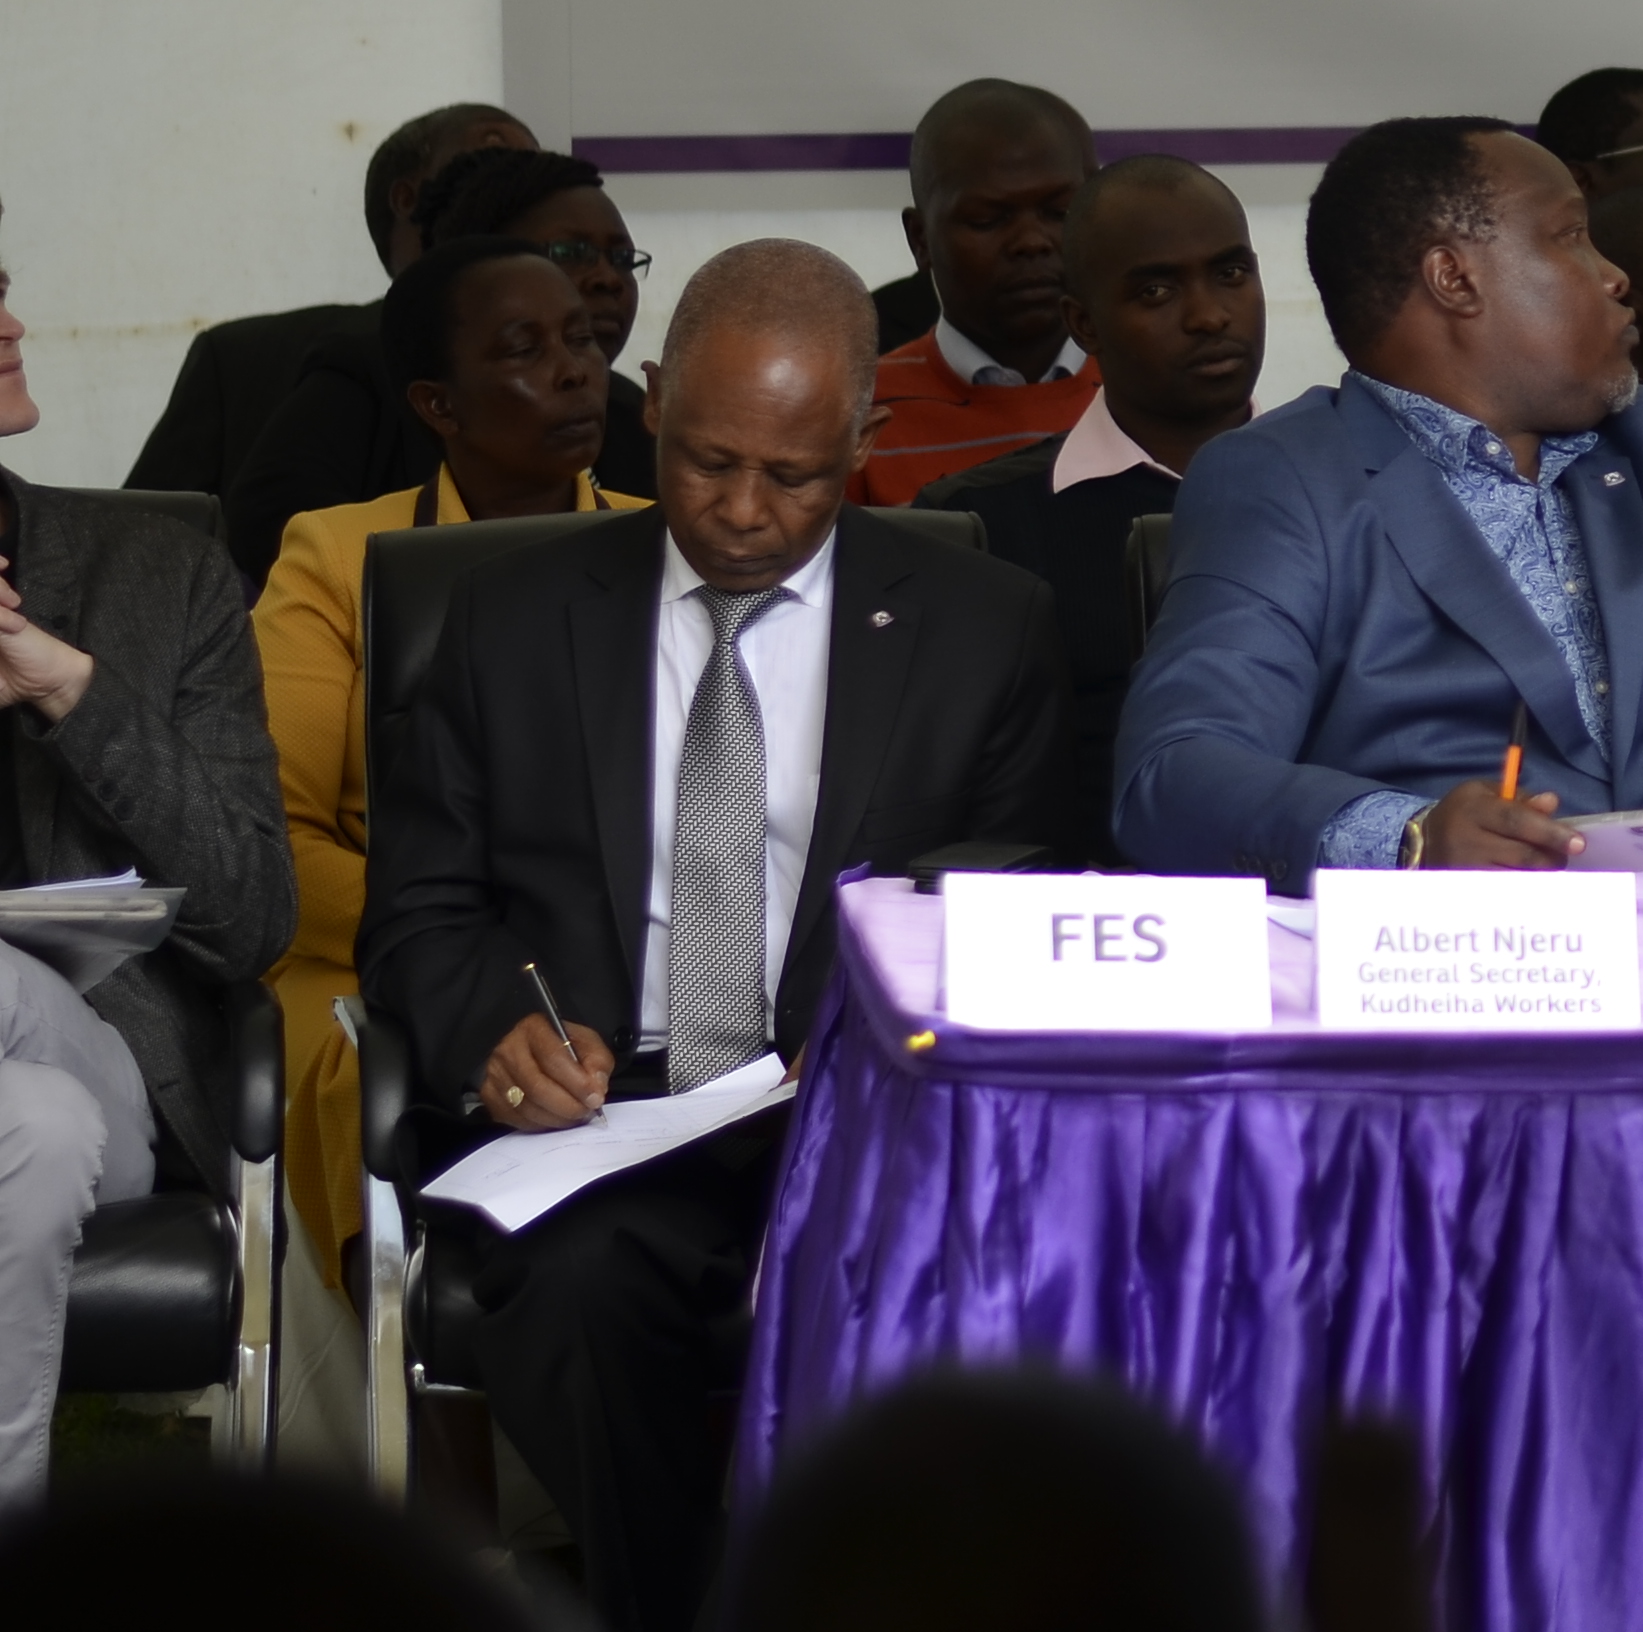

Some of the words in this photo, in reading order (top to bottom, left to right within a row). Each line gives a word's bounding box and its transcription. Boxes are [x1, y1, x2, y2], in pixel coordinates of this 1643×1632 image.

[1050, 912, 1168, 963] FES
[1375, 925, 1480, 953] Albert
[1492, 925, 1583, 960] Njeru
[1359, 962, 1460, 985] General
[1470, 962, 1602, 989] Secretary,
[1360, 991, 1486, 1014] Kudheiha
[1495, 991, 1602, 1014] Workers
